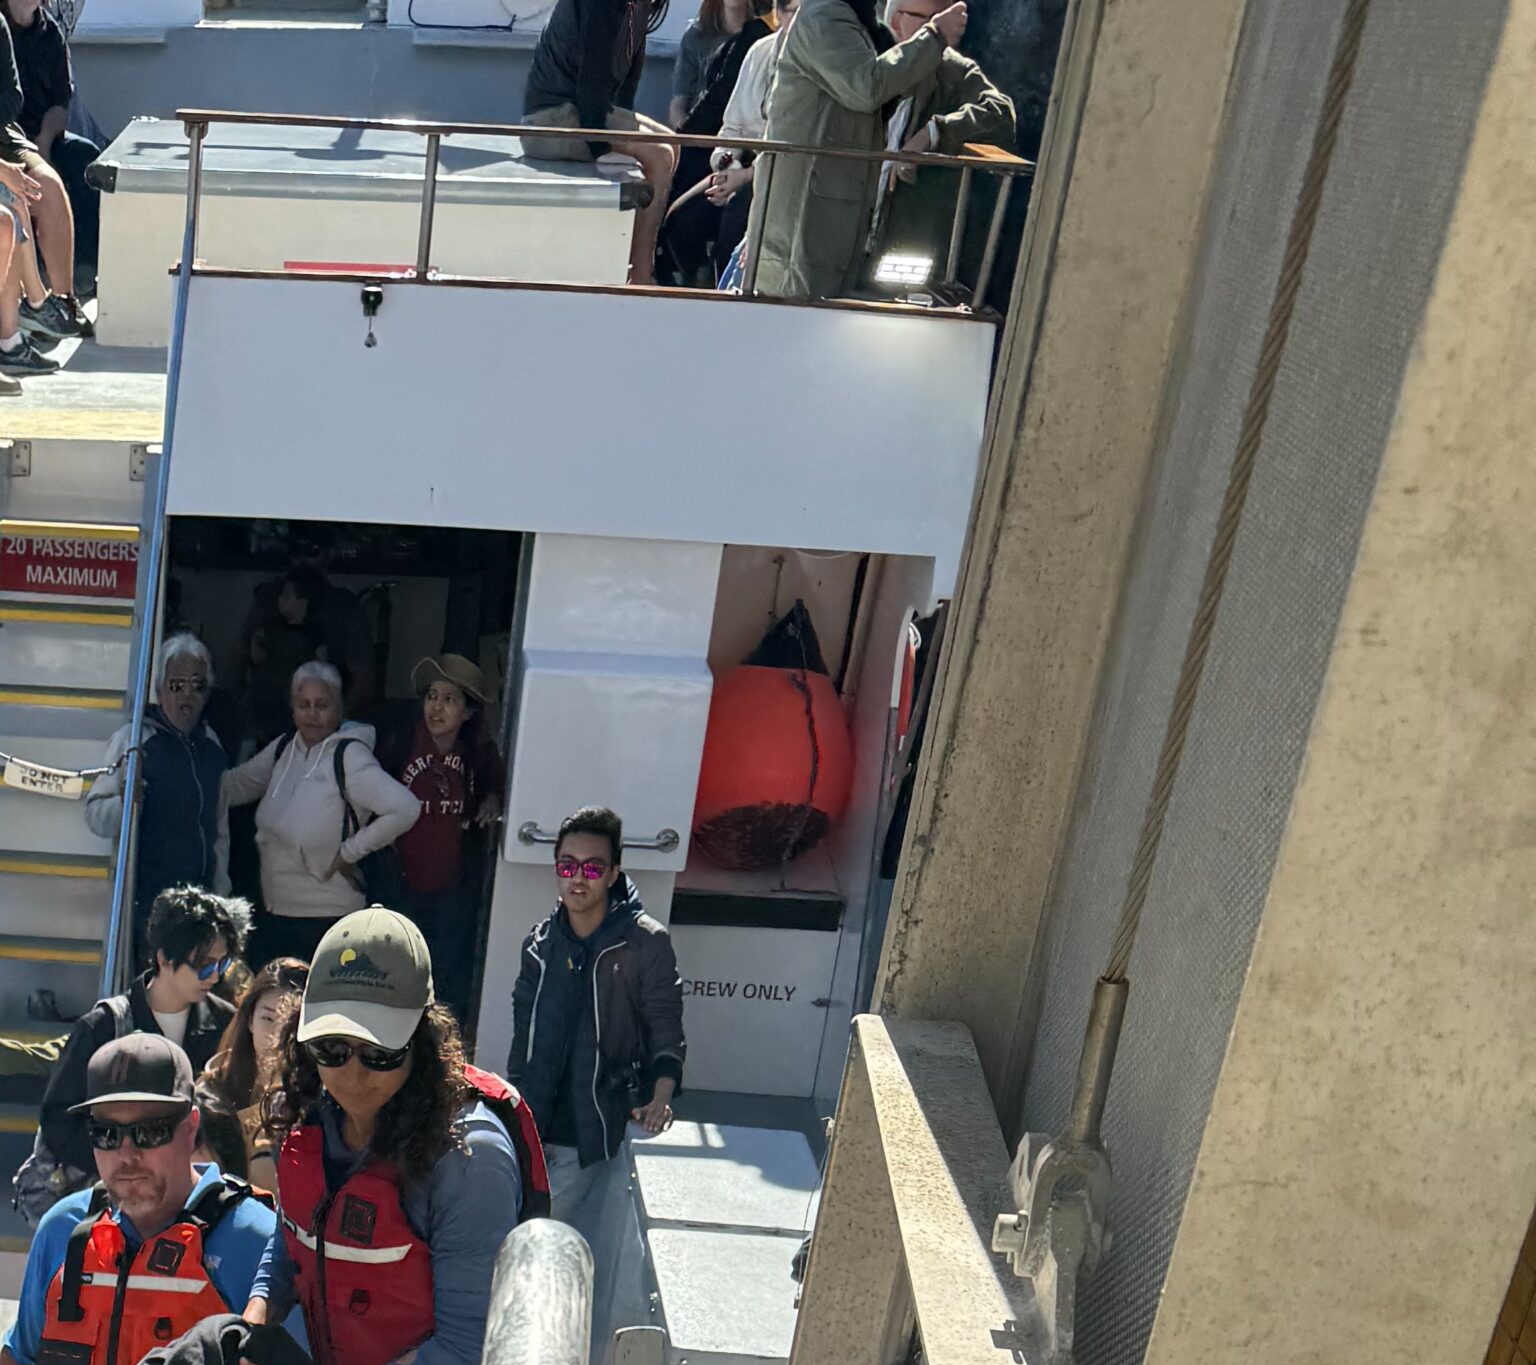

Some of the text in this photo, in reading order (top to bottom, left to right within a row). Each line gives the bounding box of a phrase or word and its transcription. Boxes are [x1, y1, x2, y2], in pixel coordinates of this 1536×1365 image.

[6, 537, 139, 562] 20 PASSENGERS
[26, 564, 117, 588] MAXIMUM
[21, 776, 64, 793] ENTER
[41, 770, 70, 784] NOT
[681, 980, 796, 1001] CREW ONLY
